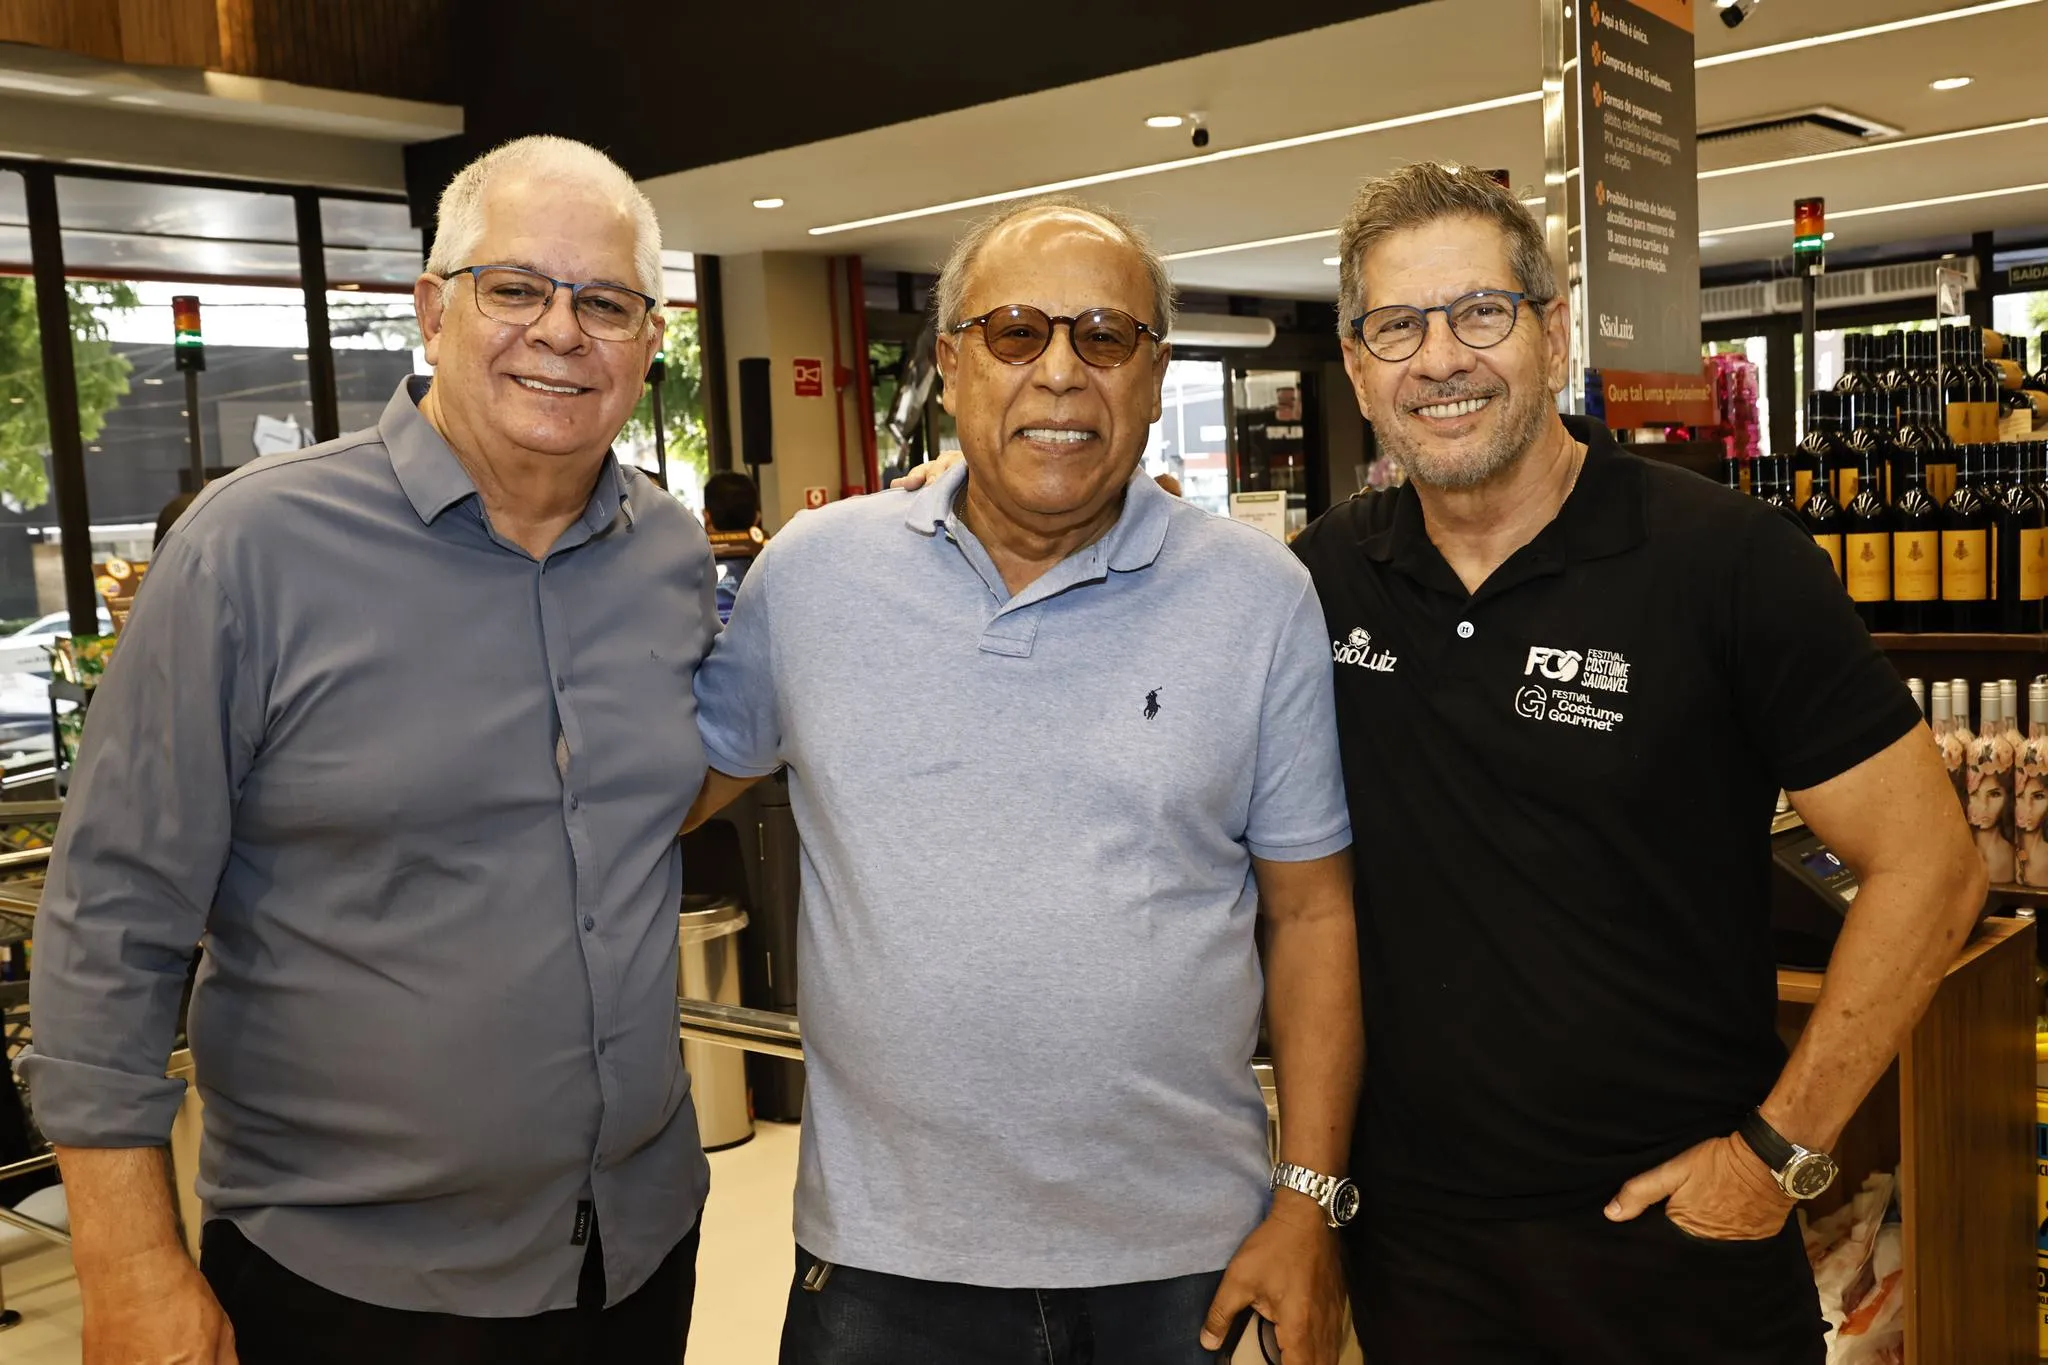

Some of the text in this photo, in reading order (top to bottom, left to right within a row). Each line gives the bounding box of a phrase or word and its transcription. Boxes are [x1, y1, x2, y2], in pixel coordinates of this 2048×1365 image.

[1601, 11, 1614, 29] Aqui
[1633, 25, 1649, 44] única.
[1602, 51, 1626, 72] Compras
[1627, 61, 1634, 76] de
[1635, 66, 1643, 80] até
[1644, 69, 1649, 82] 15
[1603, 90, 1624, 110] Formas
[1624, 98, 1631, 113] de
[1616, 136, 1635, 152] cartões
[1650, 202, 1656, 215] de
[1608, 229, 1613, 242] 18
[1614, 233, 1627, 246] anos
[1632, 237, 1641, 249] nos
[1634, 219, 1645, 232] para
[1669, 225, 1675, 239] de
[1608, 384, 1629, 402] Que
[1629, 384, 1643, 402] tal
[1644, 388, 1664, 401] uma
[1587, 648, 1625, 663] FESTIVAL
[1585, 656, 1631, 678] COSTUME
[1552, 689, 1592, 704] FESTIVAL
[1548, 708, 1615, 732] Gourmet
[1558, 699, 1624, 722] Costume
